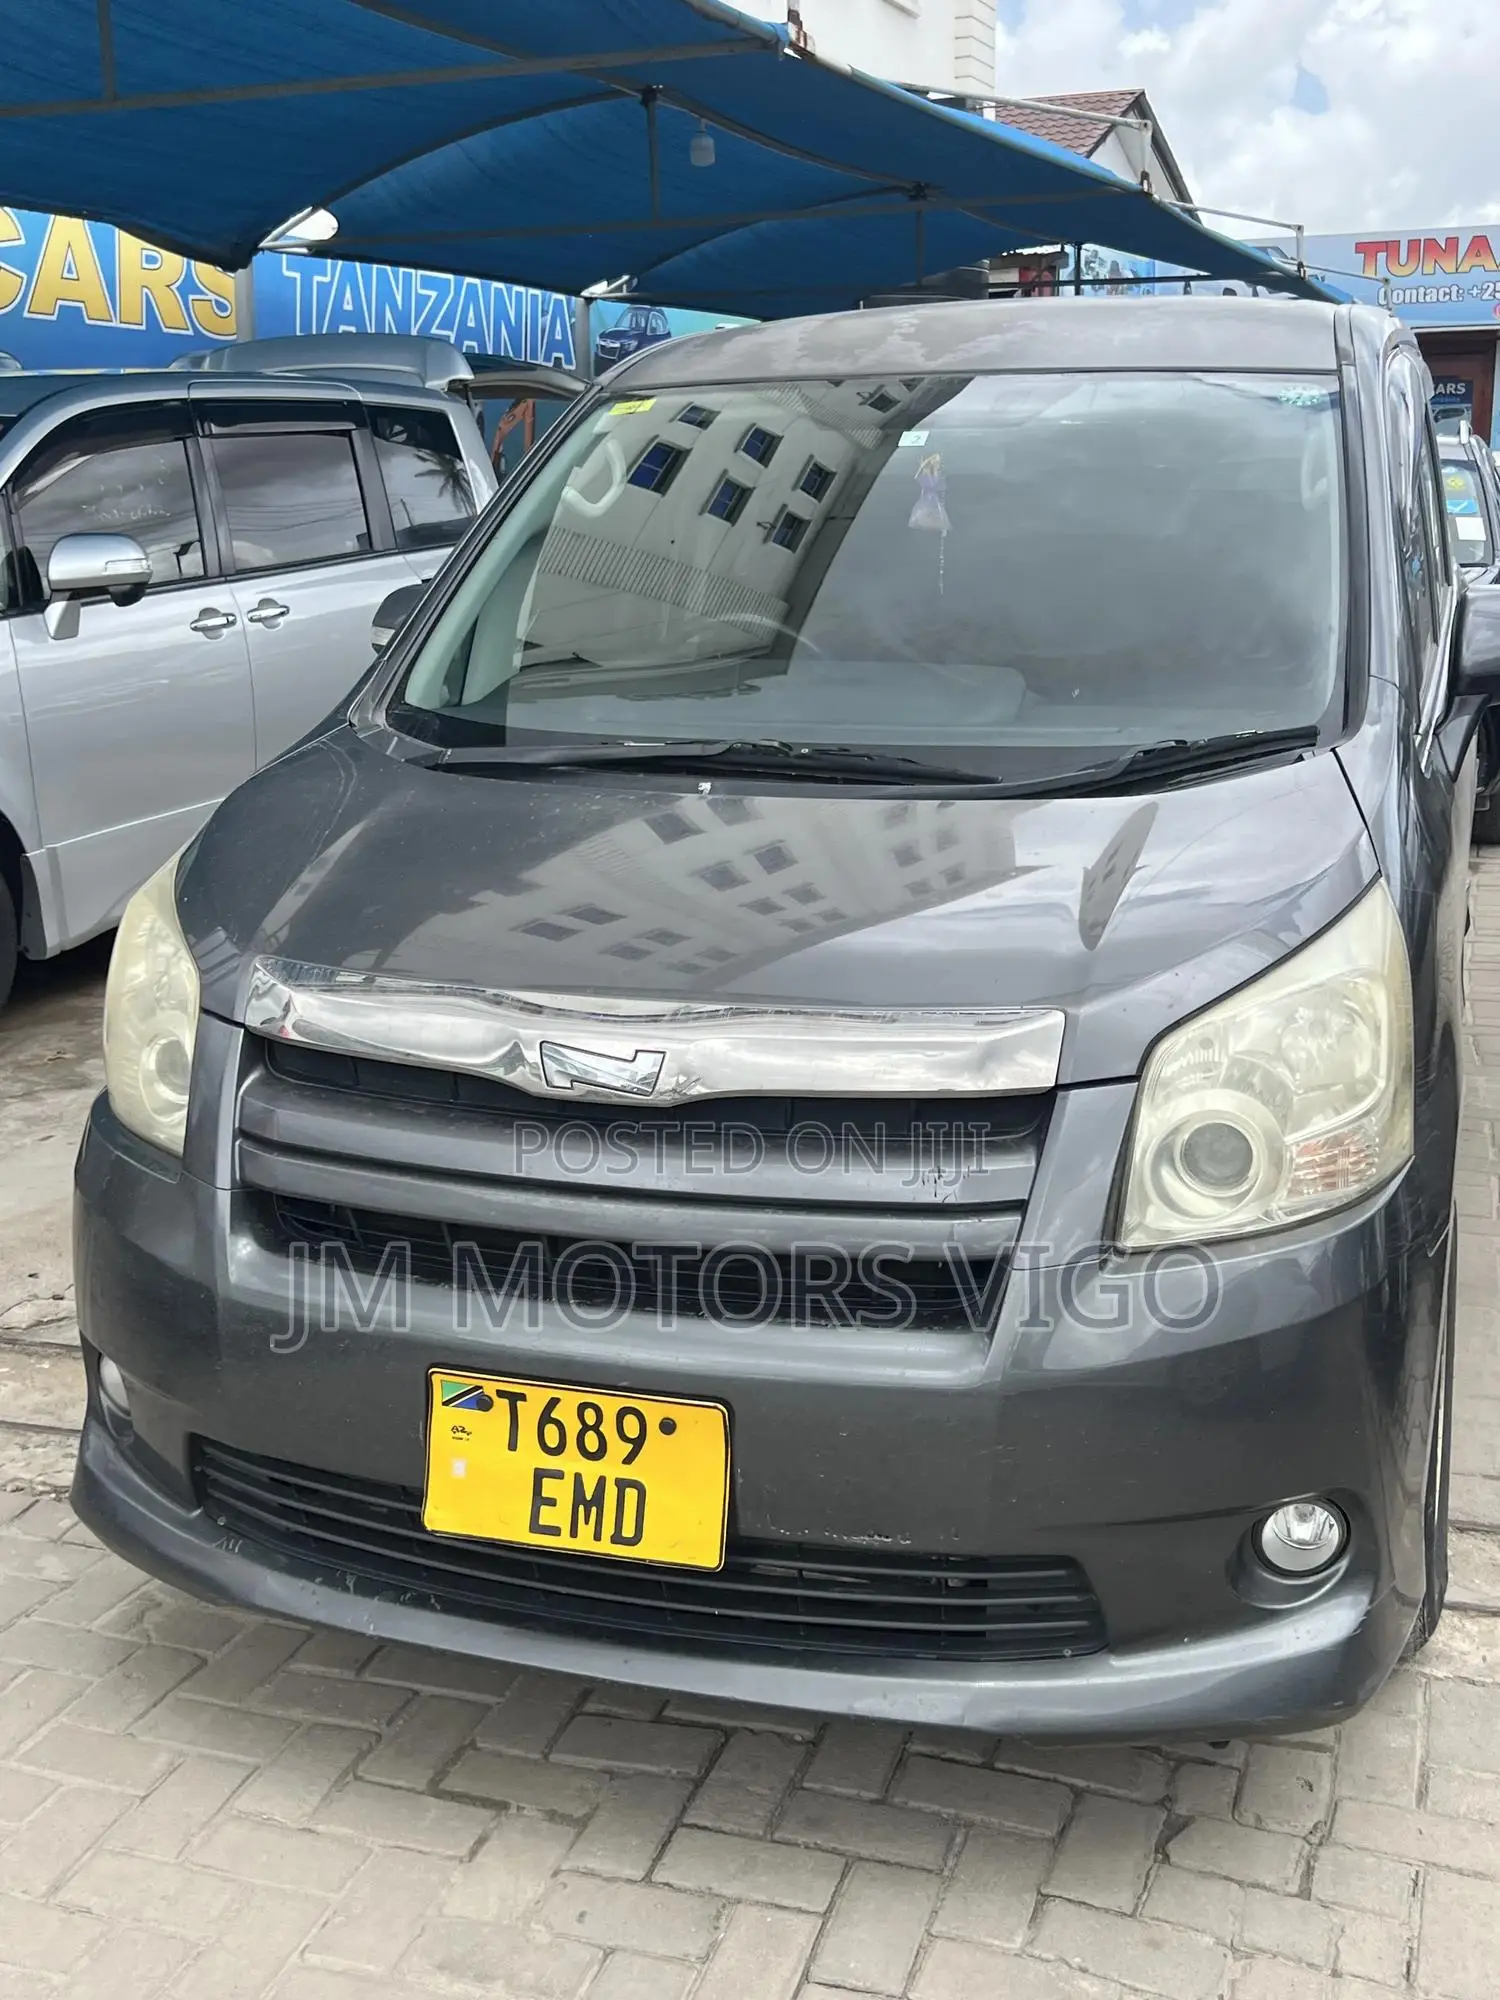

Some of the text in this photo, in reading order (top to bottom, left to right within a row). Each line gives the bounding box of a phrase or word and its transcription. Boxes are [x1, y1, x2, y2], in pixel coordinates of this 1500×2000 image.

[1355, 235, 1500, 277] TUNA
[282, 254, 576, 370] TANZANIA
[1377, 284, 1465, 306] Contact:
[1434, 383, 1466, 395] ARS
[496, 1389, 648, 1465] T689
[529, 1467, 648, 1547] EMD
